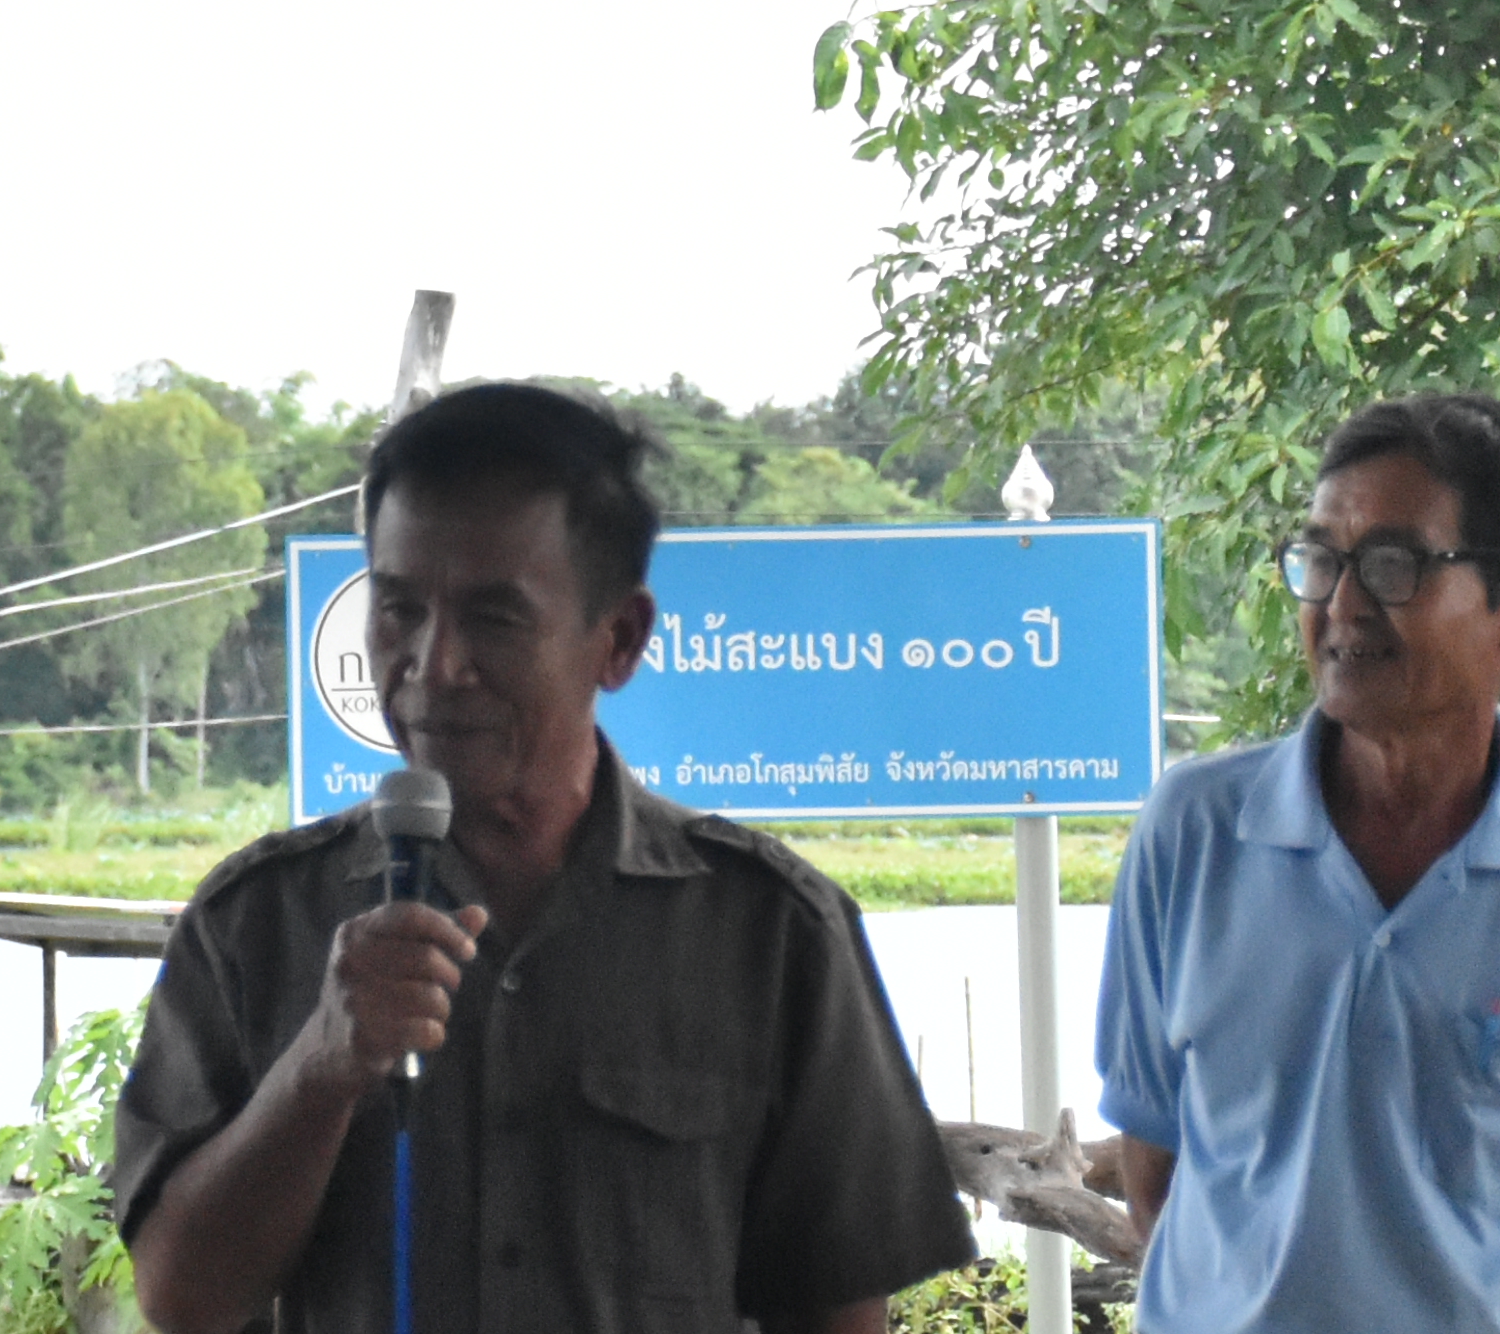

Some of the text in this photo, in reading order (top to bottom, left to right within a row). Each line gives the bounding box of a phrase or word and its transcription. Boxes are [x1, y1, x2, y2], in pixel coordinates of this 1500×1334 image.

[643, 612, 884, 673] งไม้สะแบง
[676, 753, 869, 795] อำเภอโกสุมพิสัย
[886, 750, 1119, 782] จังหวัดมหาสารคาม
